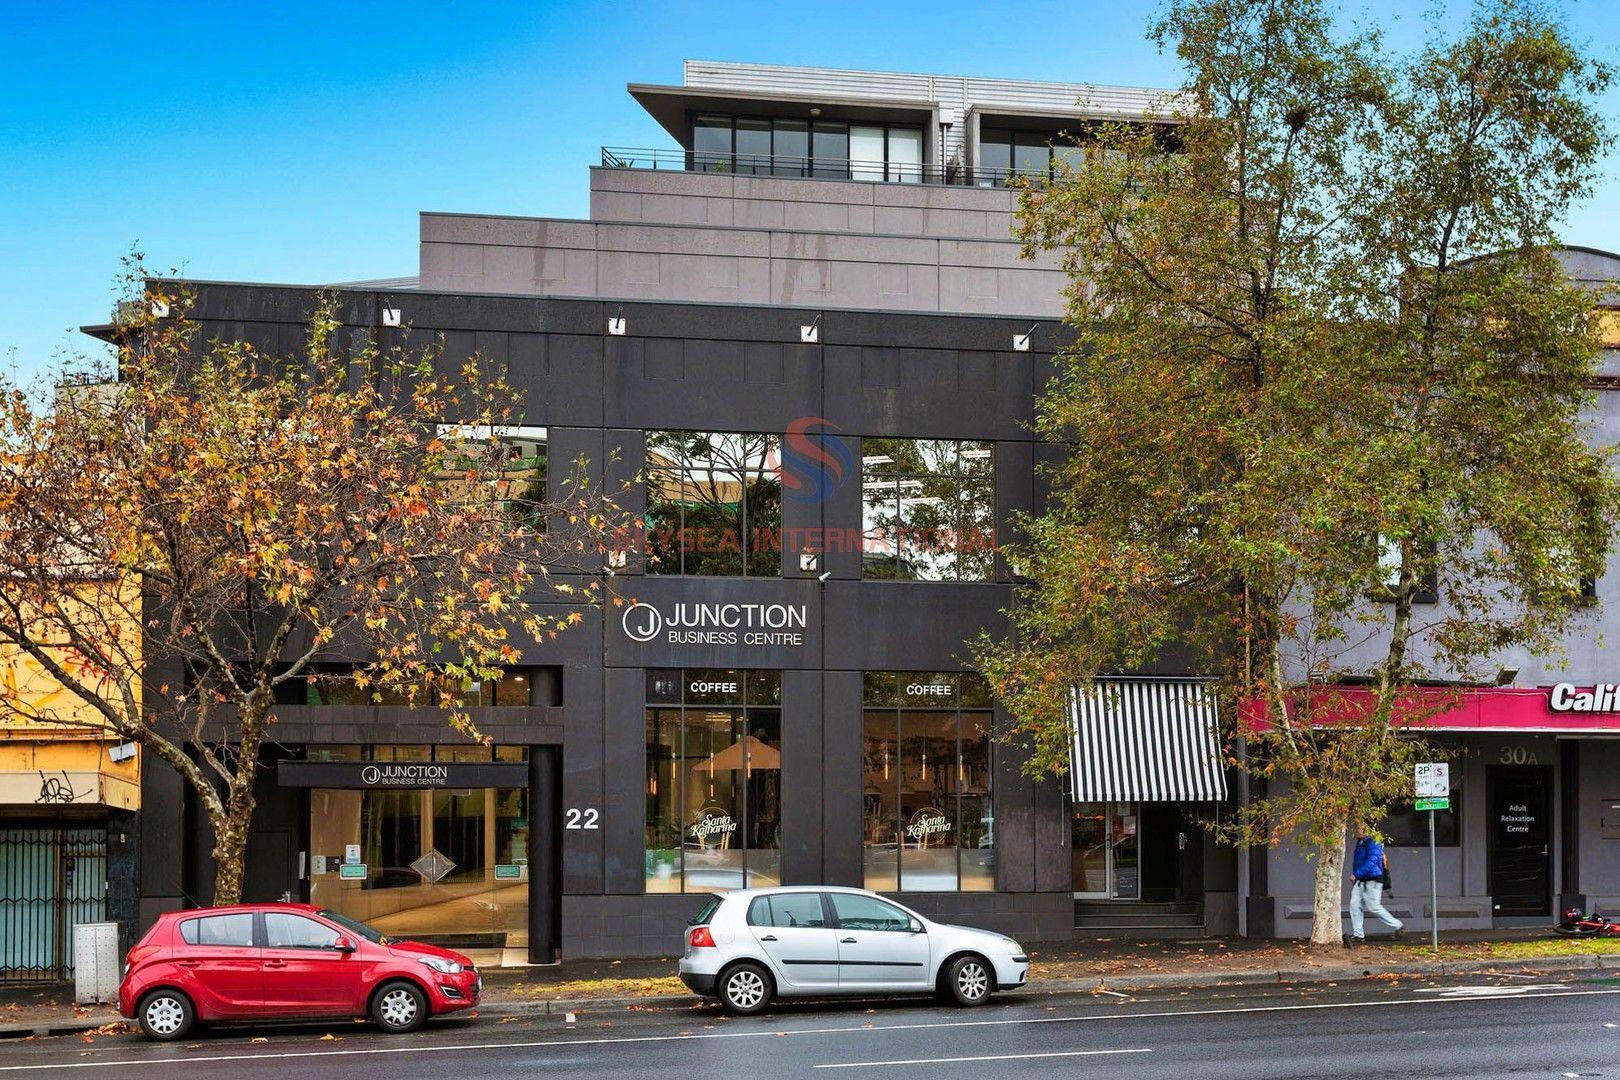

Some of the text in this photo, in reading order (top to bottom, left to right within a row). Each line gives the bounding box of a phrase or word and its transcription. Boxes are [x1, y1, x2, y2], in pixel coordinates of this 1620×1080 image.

[665, 603, 806, 628] JUNCTION
[668, 631, 802, 646] BUSINESS CENTRE
[690, 682, 737, 694] COFFEE
[906, 684, 951, 696] COFFEE
[1499, 746, 1538, 765] 30A
[382, 766, 447, 777] JUNCTION
[1418, 766, 1429, 775] 2P
[1508, 804, 1527, 812] Adult
[566, 809, 599, 829] 22
[702, 813, 732, 827] Santa
[918, 814, 946, 827] Santa
[690, 822, 737, 839] Katharina
[906, 823, 952, 840] Katharina
[1506, 825, 1529, 833] Centre
